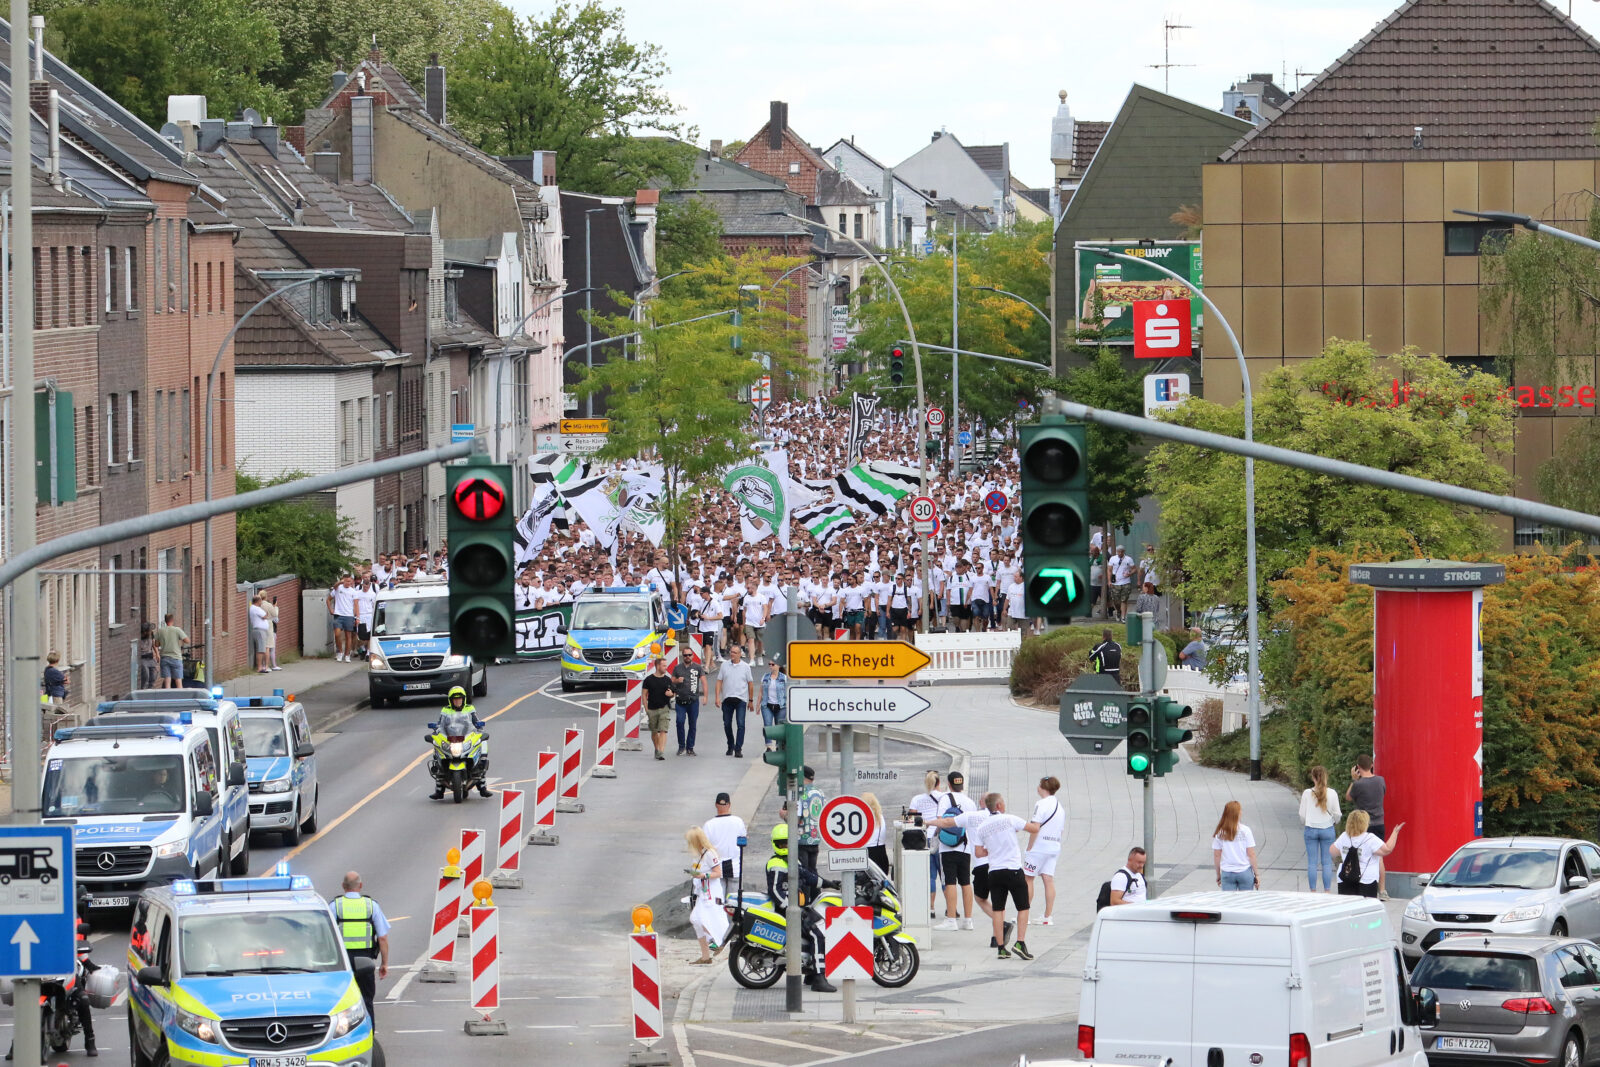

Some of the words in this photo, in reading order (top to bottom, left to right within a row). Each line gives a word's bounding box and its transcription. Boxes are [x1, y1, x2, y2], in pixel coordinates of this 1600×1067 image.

[1125, 248, 1170, 257] SUBWAY
[930, 412, 942, 422] 30
[915, 503, 931, 516] 30
[1443, 571, 1482, 581] STRÖER
[809, 653, 895, 671] MG-Rheydt
[808, 698, 896, 712] Hochschule
[1074, 701, 1093, 711] RIOT
[1073, 710, 1096, 720] ULTRA
[857, 770, 898, 780] Bahnstraße
[831, 811, 863, 836] 30
[75, 826, 141, 836] POLIZEI
[112, 898, 129, 906] 5939
[754, 926, 785, 943] POLIZEI
[231, 991, 312, 1003] POLIZEI
[1443, 1037, 1454, 1047] MG
[1458, 1039, 1469, 1048] KI
[1469, 1040, 1489, 1049] 2222
[255, 1058, 272, 1067] NRW
[275, 1058, 281, 1067] 5
[285, 1057, 305, 1067] 3426
